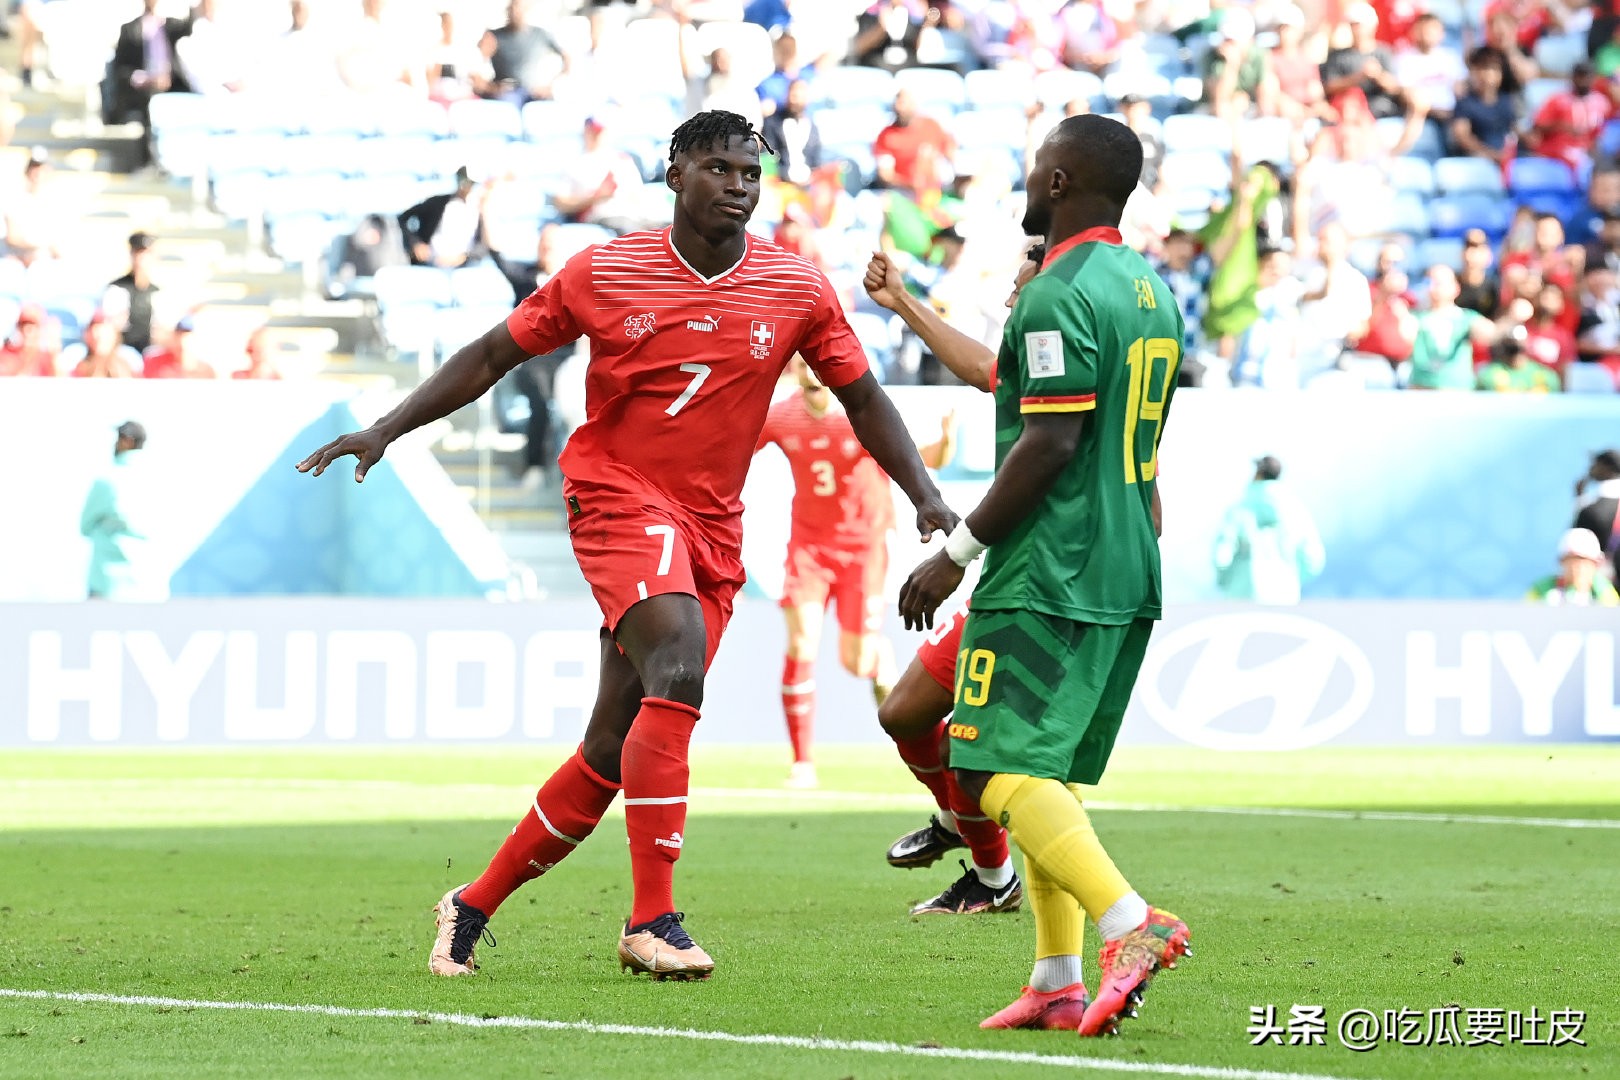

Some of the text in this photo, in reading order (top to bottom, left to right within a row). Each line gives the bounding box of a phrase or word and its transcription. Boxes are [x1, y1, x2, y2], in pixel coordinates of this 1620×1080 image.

[686, 320, 714, 333] PUMA
[664, 363, 712, 417] 7
[1123, 336, 1180, 485] 19
[810, 459, 837, 497] 3
[644, 524, 676, 577] 7
[954, 647, 996, 707] 19
[950, 724, 978, 741] one
